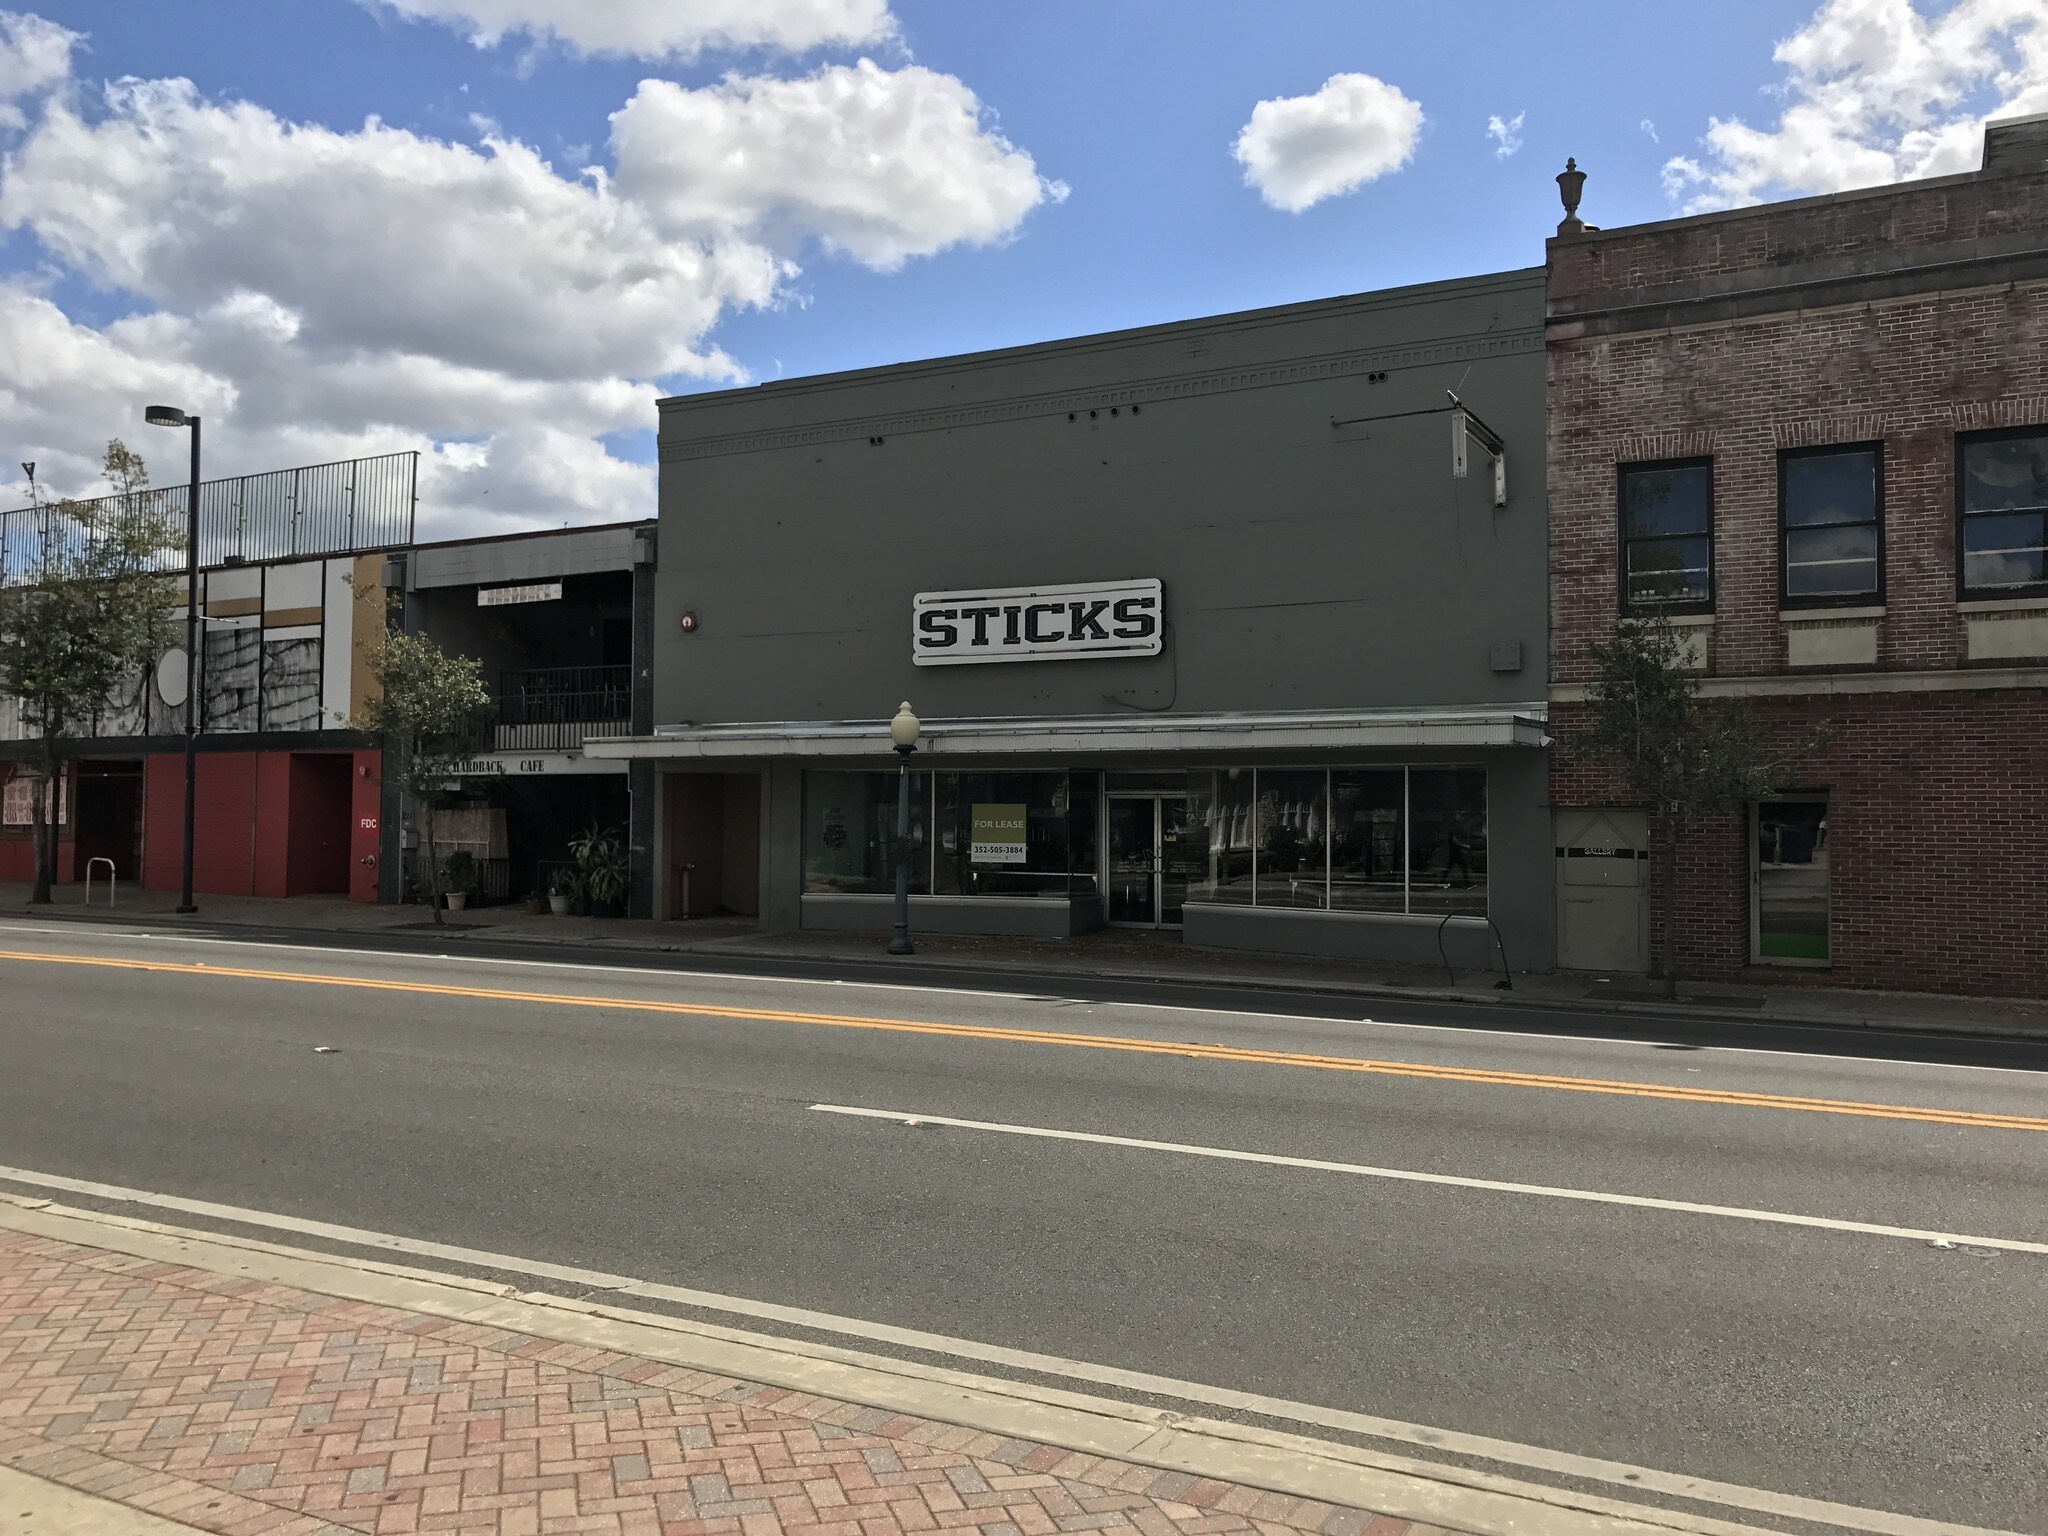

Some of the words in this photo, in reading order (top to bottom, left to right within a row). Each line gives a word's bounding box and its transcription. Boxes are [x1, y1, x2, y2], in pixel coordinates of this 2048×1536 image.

[919, 597, 1155, 647] STICKS
[452, 760, 503, 773] HARDBACK
[520, 759, 545, 772] CAFE
[361, 818, 377, 829] FDC
[974, 820, 993, 828] FOR
[995, 820, 1024, 829] LEASE
[974, 846, 1023, 854] 352-505-3884
[1584, 847, 1616, 855] GALLERY
